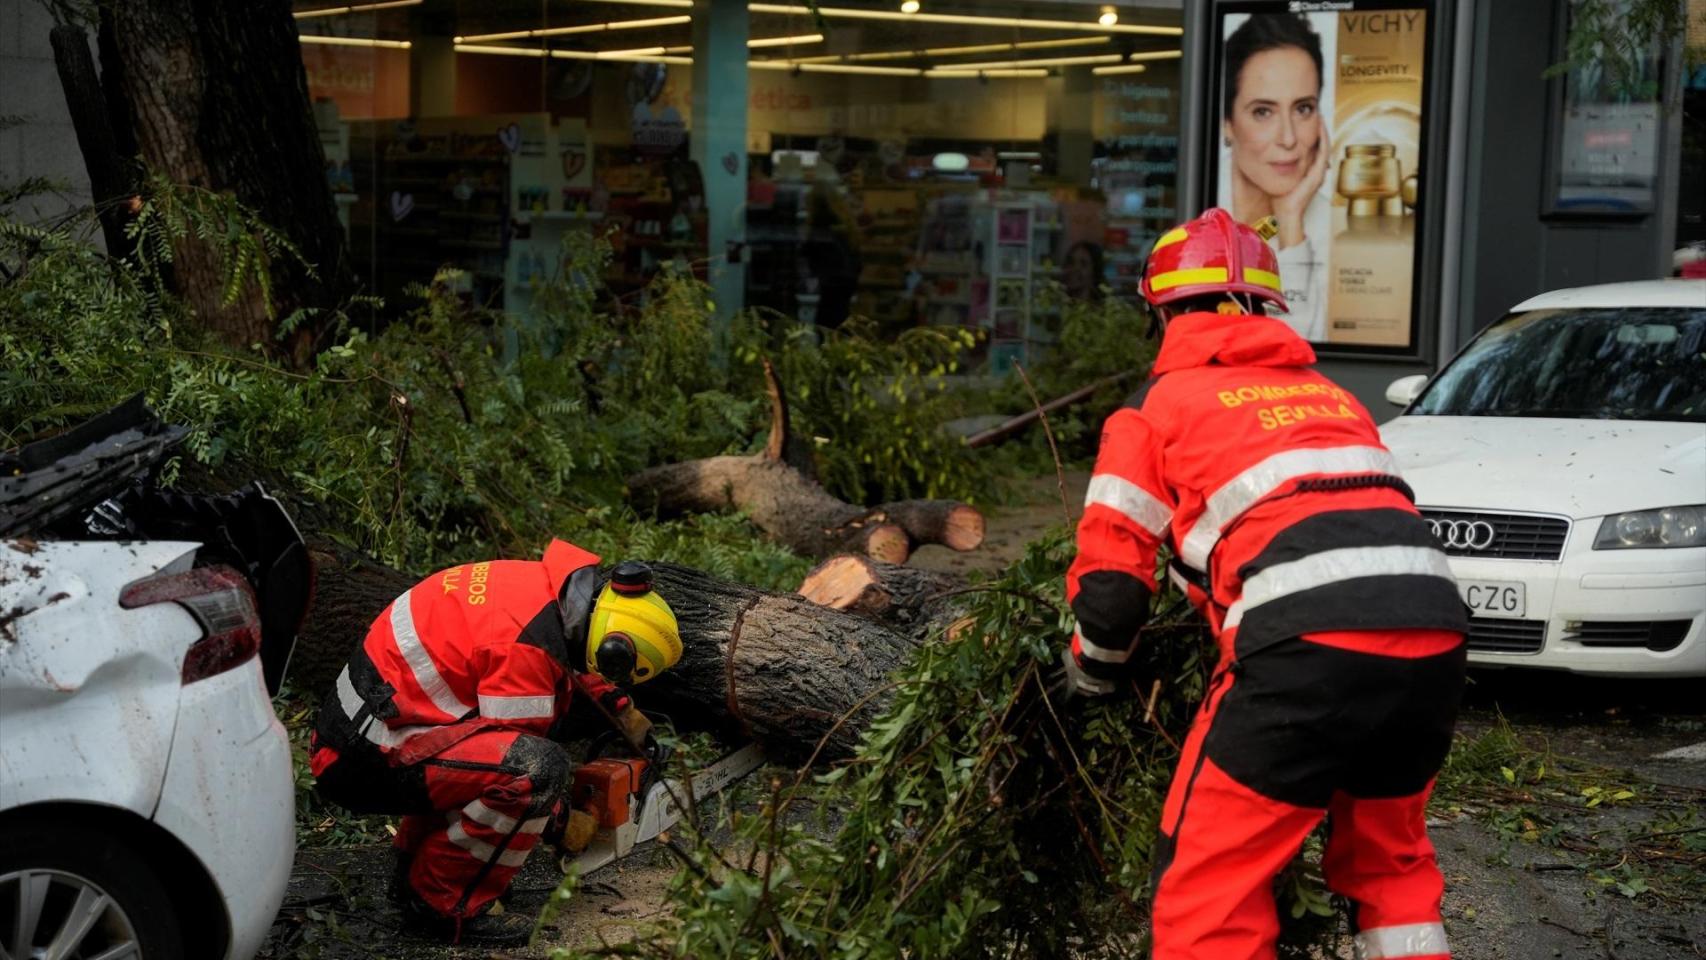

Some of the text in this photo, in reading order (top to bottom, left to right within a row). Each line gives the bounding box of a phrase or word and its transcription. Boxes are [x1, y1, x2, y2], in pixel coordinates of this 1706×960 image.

[1343, 13, 1420, 34] VICHY
[1340, 64, 1408, 77] LONGEVITY
[1467, 585, 1517, 612] CZG
